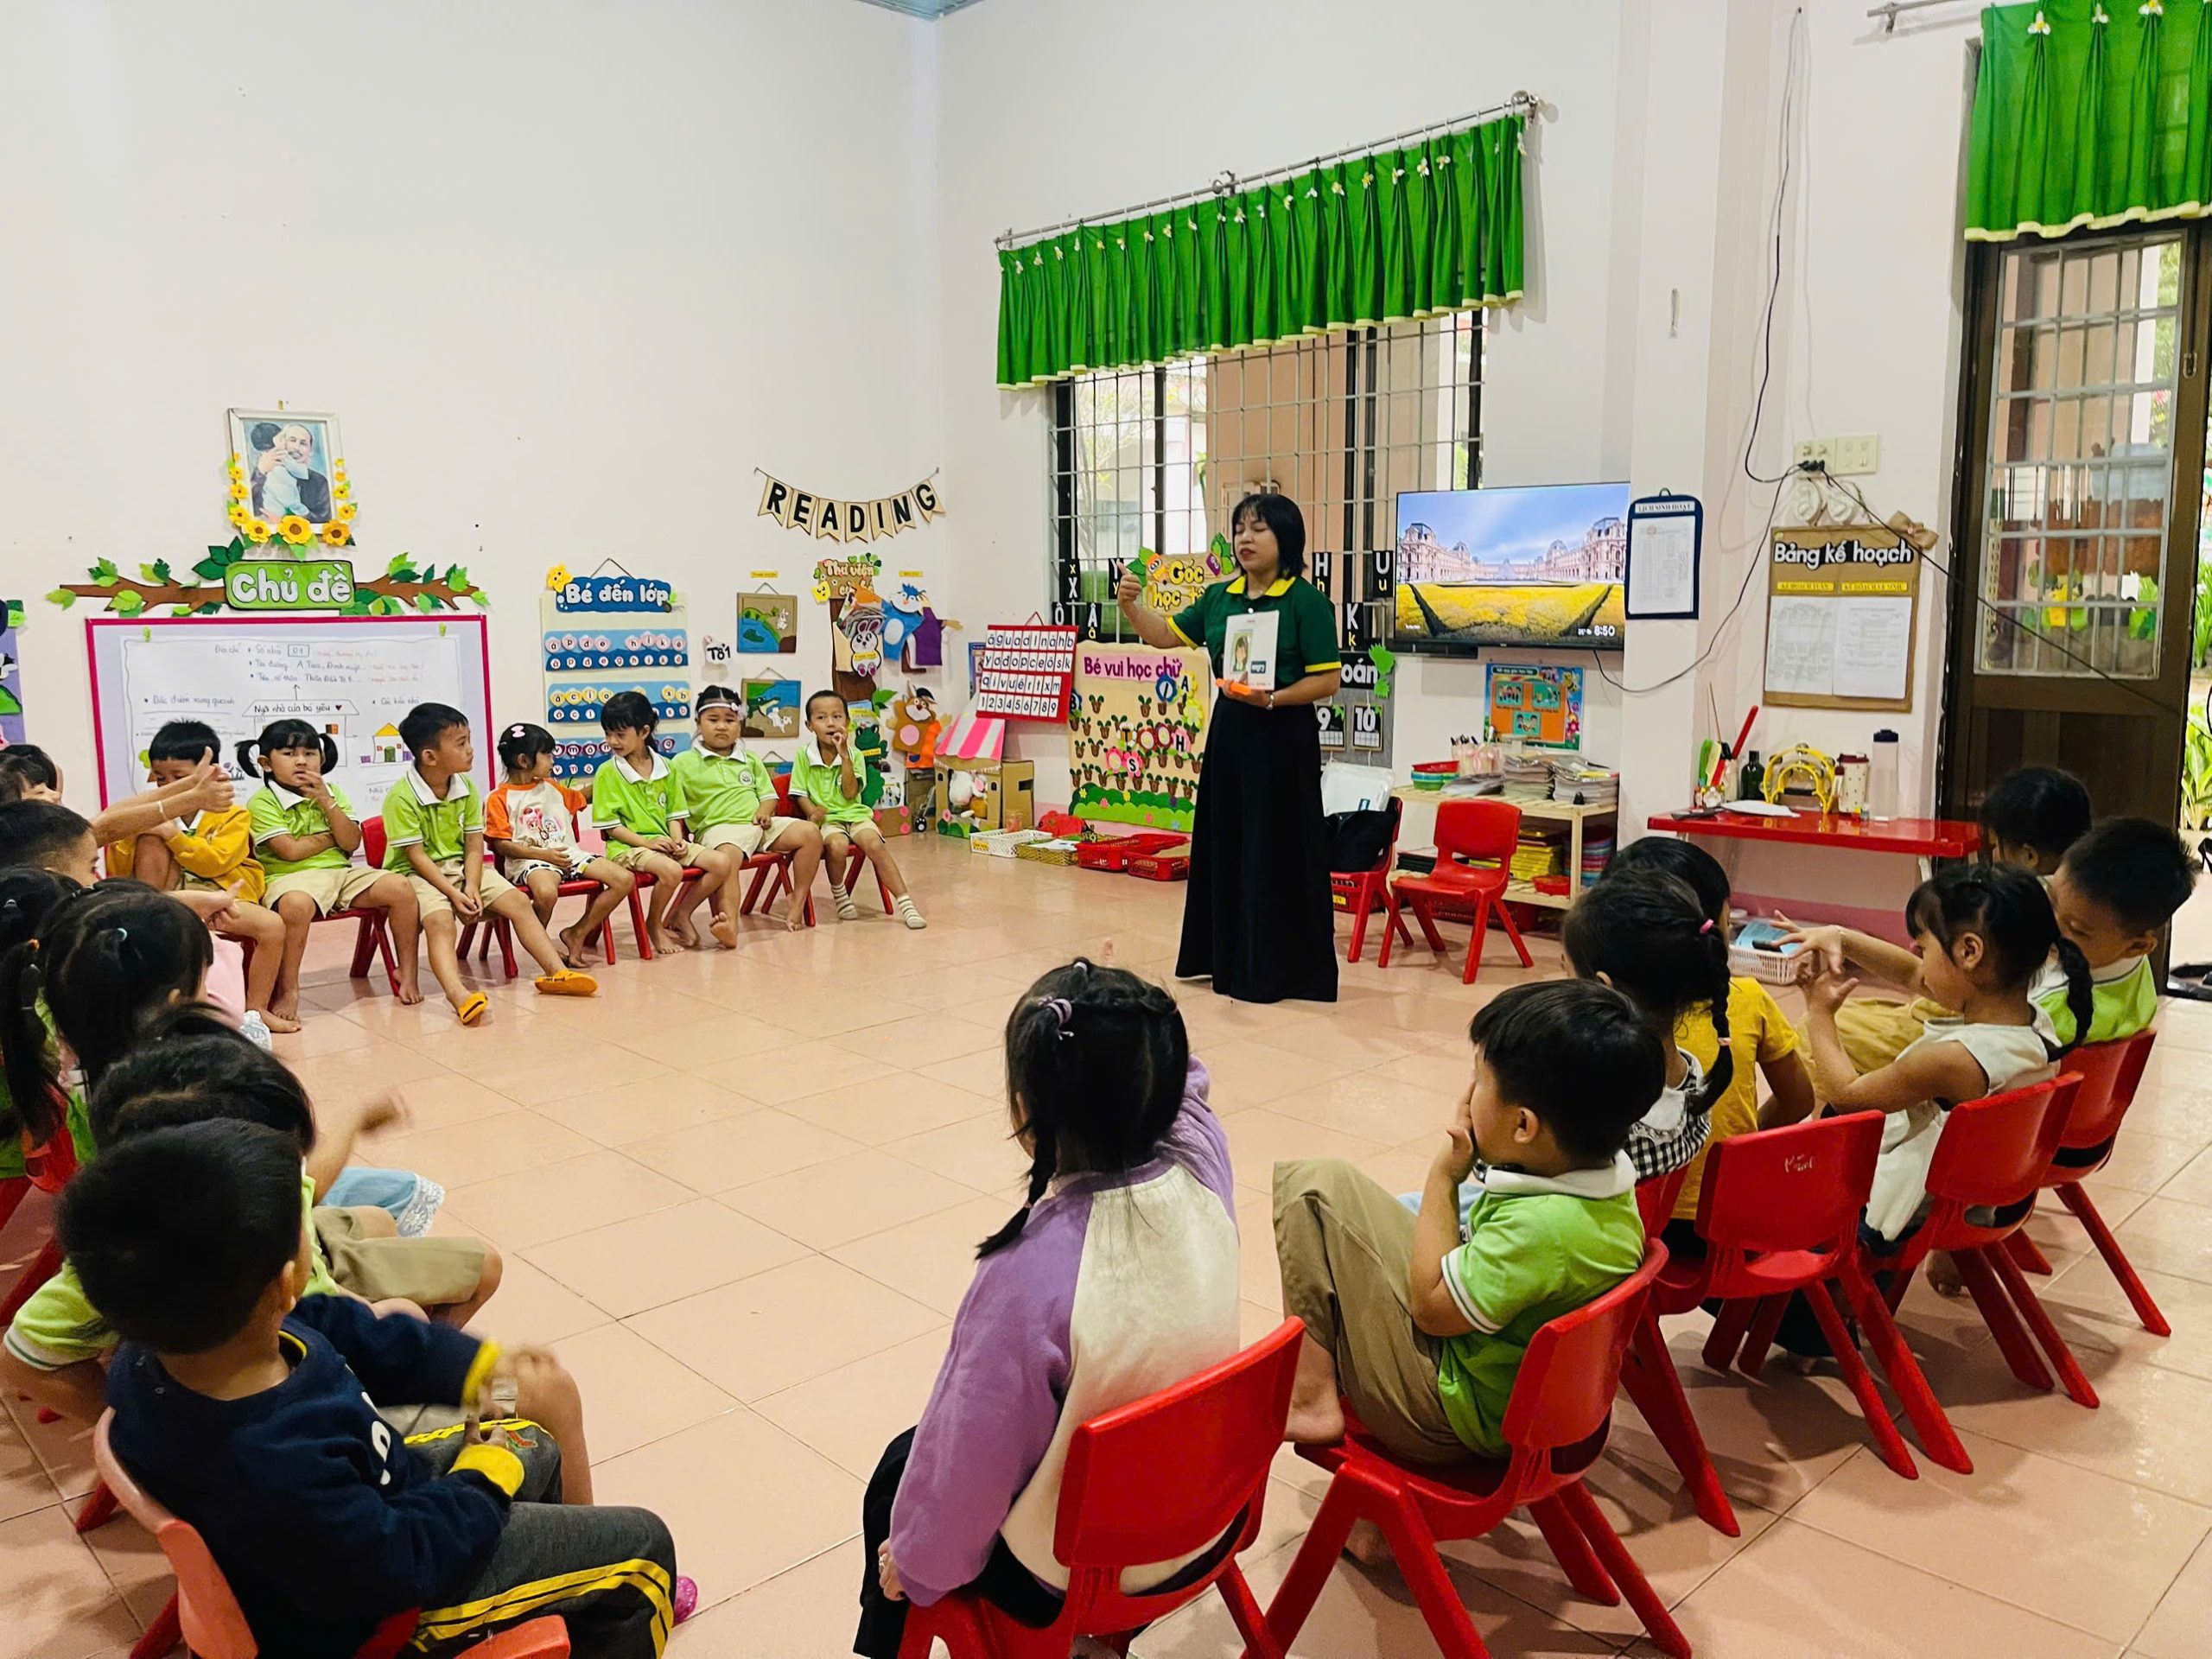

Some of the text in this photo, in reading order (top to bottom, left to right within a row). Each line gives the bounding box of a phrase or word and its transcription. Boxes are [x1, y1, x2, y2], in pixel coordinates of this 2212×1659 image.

[766, 482, 936, 532] READING
[1314, 553, 1329, 576] H
[1376, 551, 1390, 575] U
[1774, 537, 1913, 570] Bảng kế hoạch
[1070, 564, 1076, 574] x
[1169, 558, 1205, 585] Góc
[232, 563, 351, 603] Chủ đề
[565, 579, 669, 607] Bé đến lớp
[1068, 577, 1078, 599] X
[1378, 579, 1388, 591] u
[1152, 583, 1182, 611] học
[1087, 602, 1098, 627] Â
[1346, 602, 1359, 630] K
[1348, 632, 1357, 647] k
[1593, 625, 1616, 637] 8:50
[1084, 656, 1102, 676] Bé
[1104, 661, 1124, 677] vui
[1127, 657, 1152, 681] học
[1340, 658, 1378, 684] oán
[1180, 675, 1190, 692] A
[1317, 706, 1332, 731] 9
[1355, 707, 1376, 732] 10
[1123, 728, 1131, 743] T
[1175, 735, 1185, 753] H
[1128, 759, 1136, 772] S
